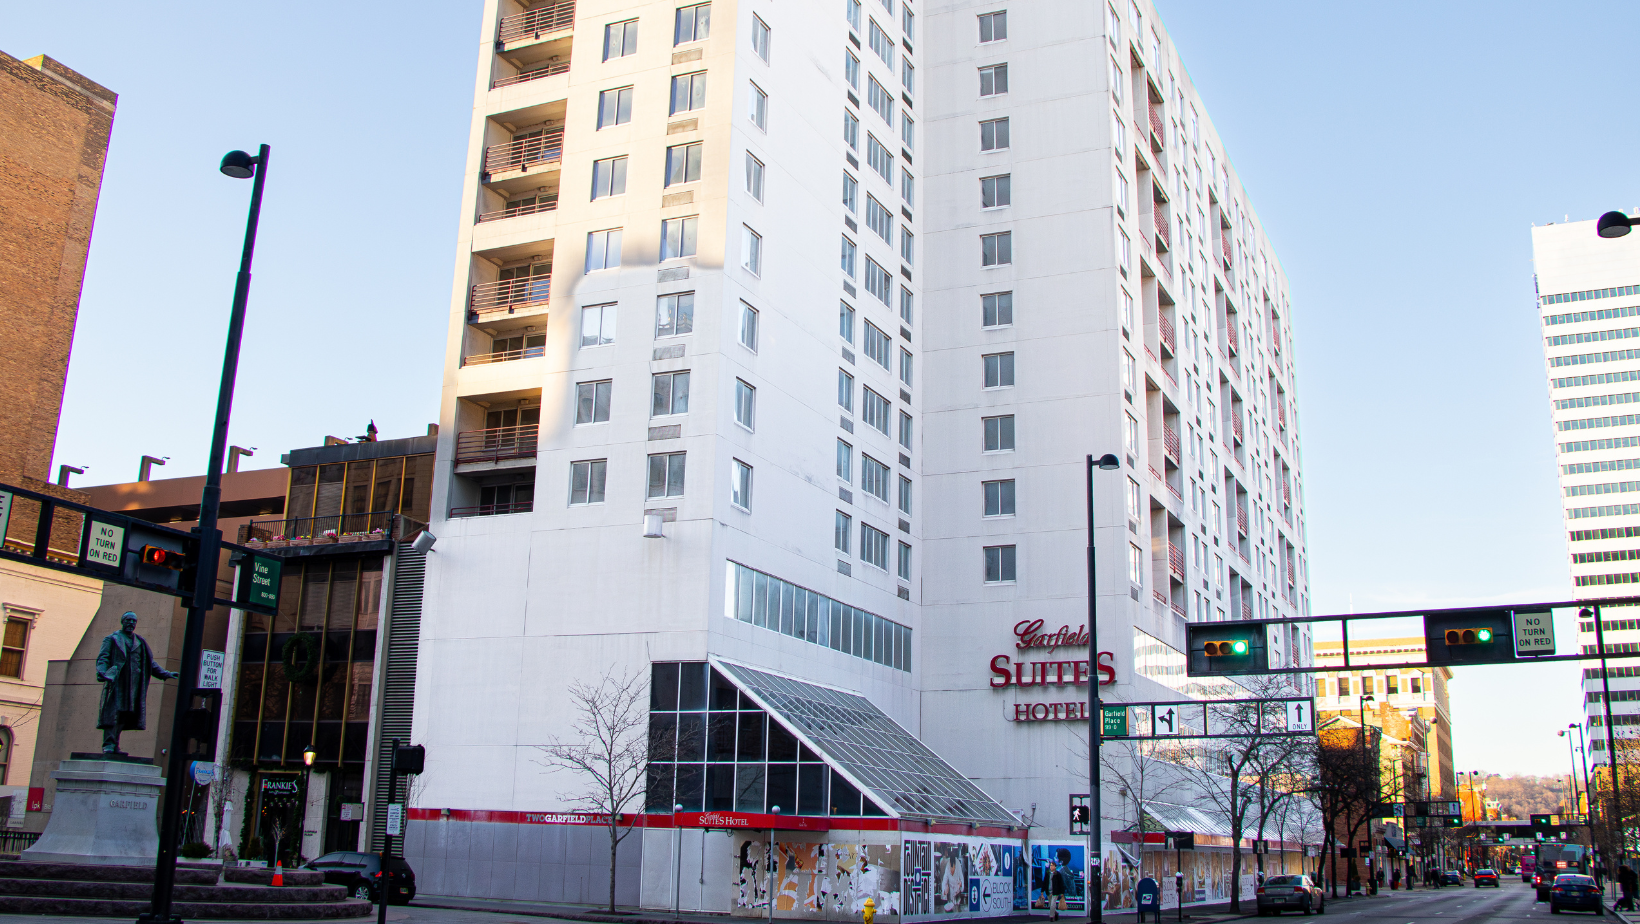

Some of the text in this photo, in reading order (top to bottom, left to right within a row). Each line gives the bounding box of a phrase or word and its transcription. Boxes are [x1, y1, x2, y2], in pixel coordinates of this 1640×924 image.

[100, 527, 114, 538] NO
[95, 538, 116, 550] TURN
[89, 548, 118, 562] ON RED
[254, 562, 269, 574] Vine
[252, 573, 271, 586] Street
[1525, 617, 1541, 626] NO
[1521, 628, 1546, 636] TURN
[1518, 637, 1551, 647] ON RED
[206, 653, 221, 661] PUSH
[202, 660, 222, 668] BUTTON
[989, 651, 1116, 688] SUITES
[1013, 702, 1089, 721] HOTEL
[109, 800, 148, 810] GARFIELD
[725, 816, 749, 826] HOTEL
[992, 881, 1012, 894] BLOCK
[992, 896, 1012, 909] SOUTH
